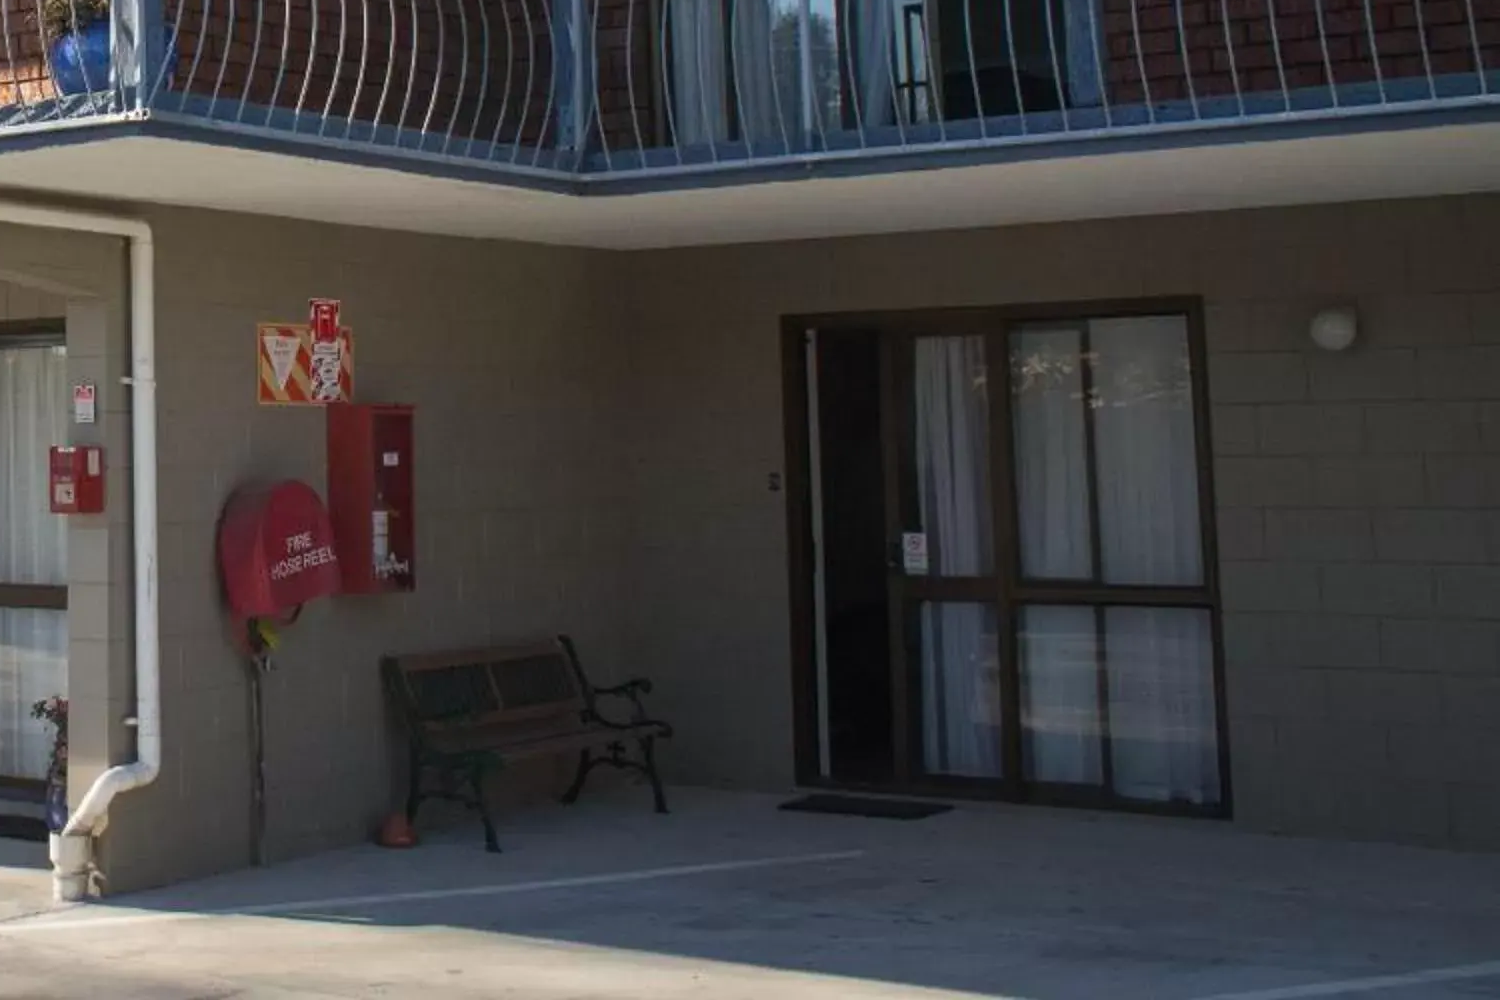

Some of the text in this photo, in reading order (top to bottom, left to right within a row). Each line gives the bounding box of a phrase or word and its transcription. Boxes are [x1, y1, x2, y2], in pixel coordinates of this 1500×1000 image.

[286, 531, 312, 552] FIRE
[272, 546, 337, 580] HOSE REEL
